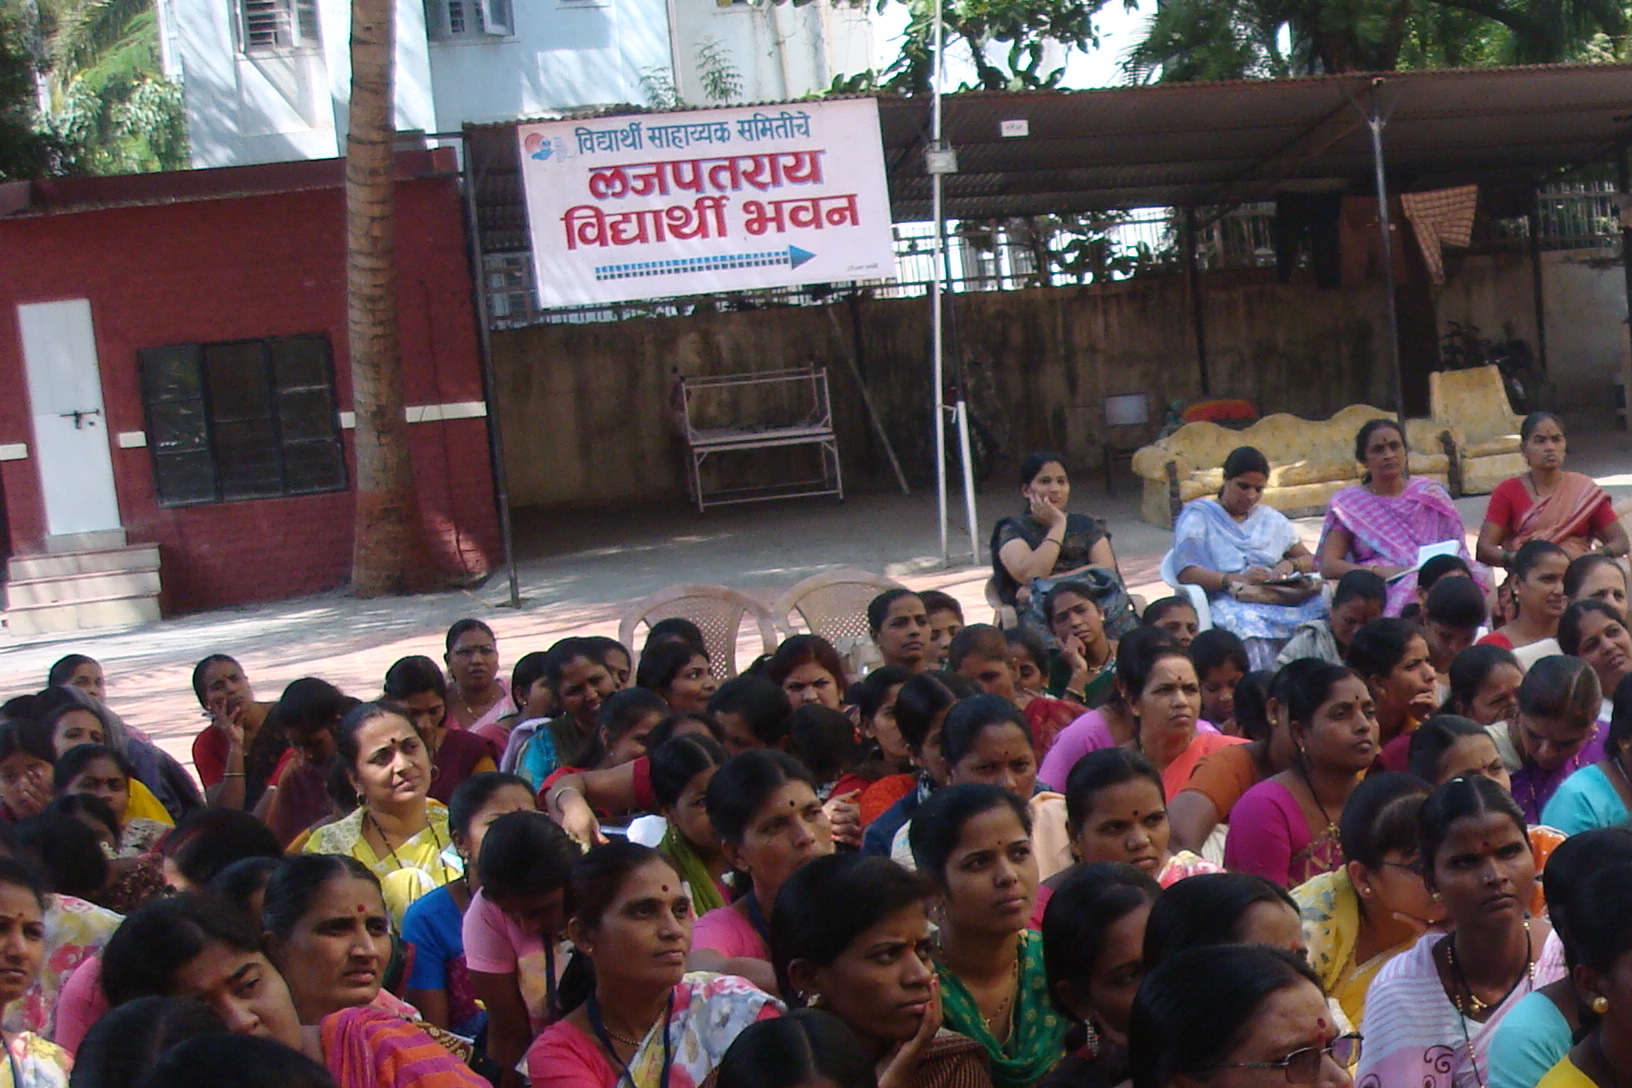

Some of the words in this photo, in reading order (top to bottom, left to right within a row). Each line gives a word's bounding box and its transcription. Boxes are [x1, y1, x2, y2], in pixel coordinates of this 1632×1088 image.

[575, 121, 643, 154] विद्यार्थी
[647, 121, 731, 149] साहाय्यक
[736, 111, 811, 141] समितीचे
[588, 149, 826, 200] लजपतराय
[559, 195, 731, 250] विद्यार्थी
[742, 193, 860, 236] भवन
